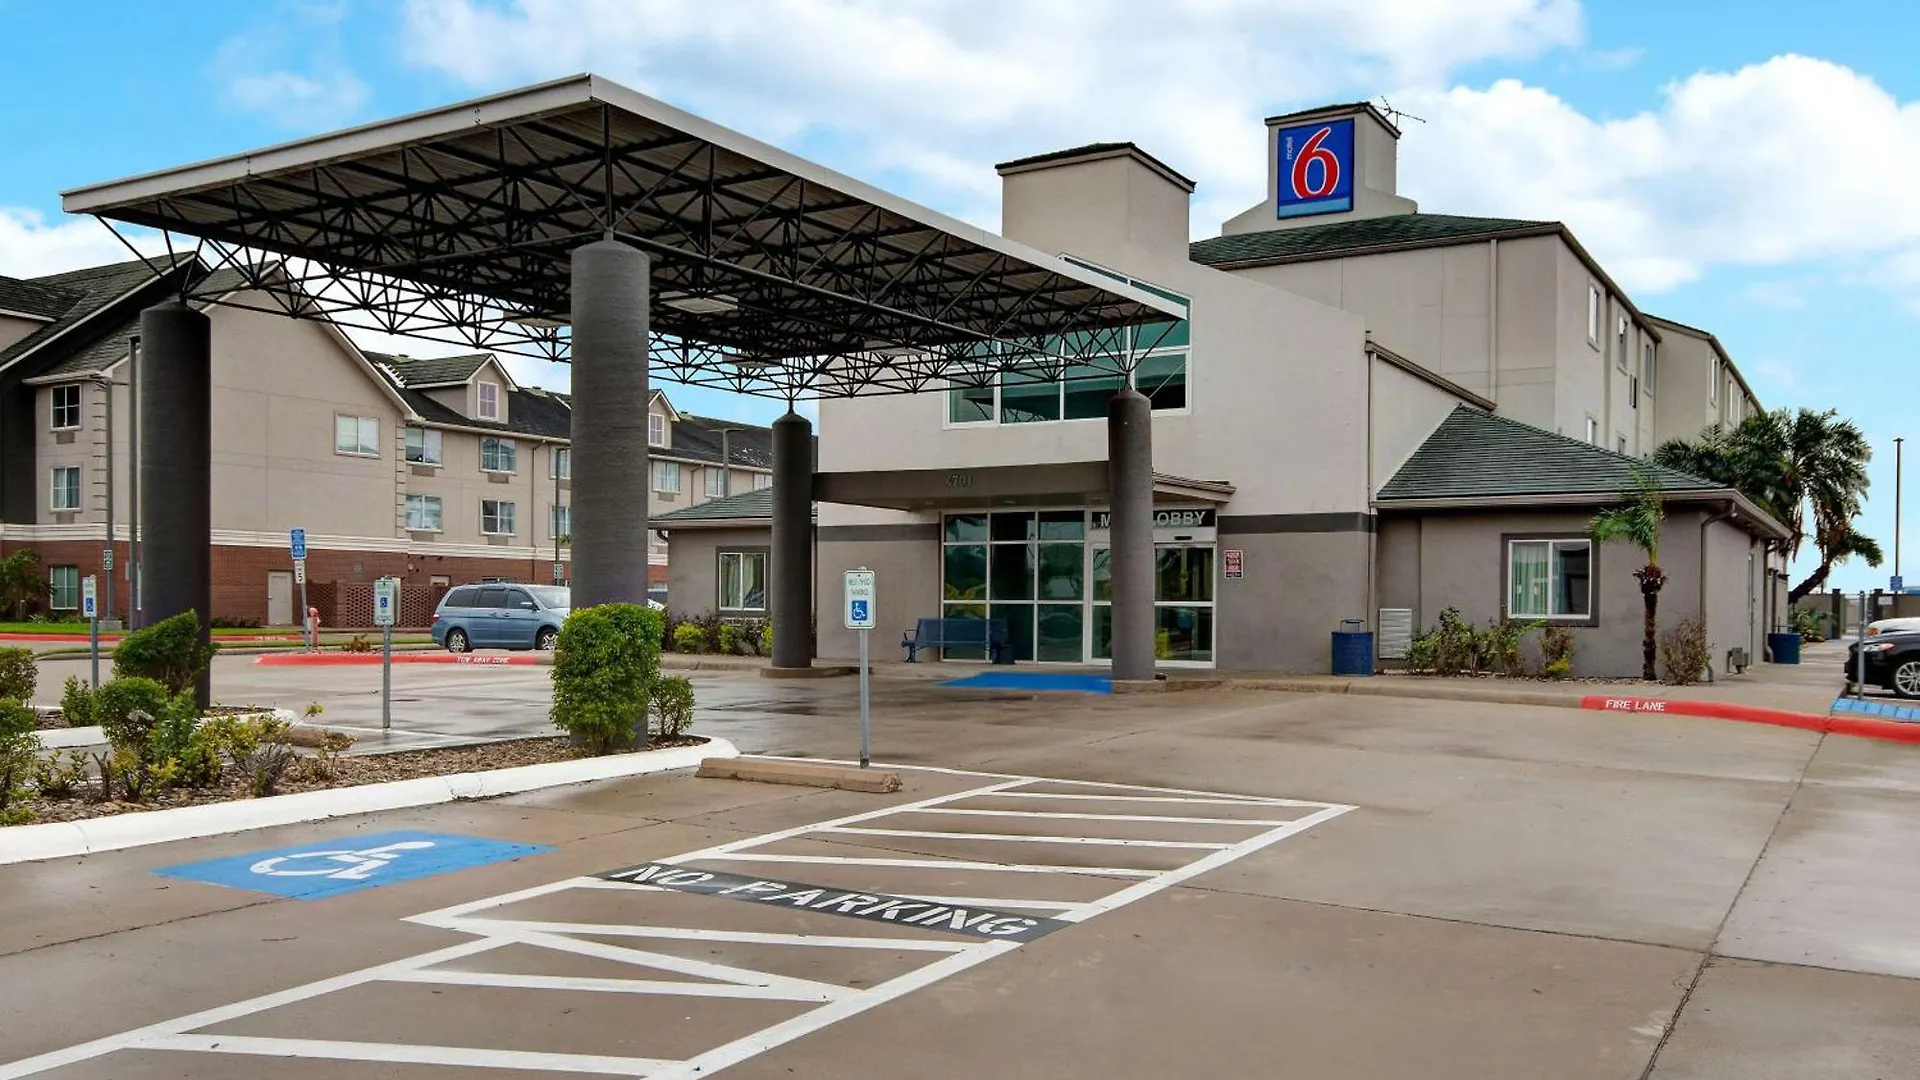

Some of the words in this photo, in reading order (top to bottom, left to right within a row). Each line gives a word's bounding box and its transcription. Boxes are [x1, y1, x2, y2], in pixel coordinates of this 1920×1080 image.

[1291, 126, 1340, 199] 6
[1152, 511, 1206, 526] OBBY
[1605, 699, 1632, 710] FIRE
[1635, 701, 1666, 711] LANE
[609, 865, 715, 885] NO
[717, 881, 1038, 935] PARKING
